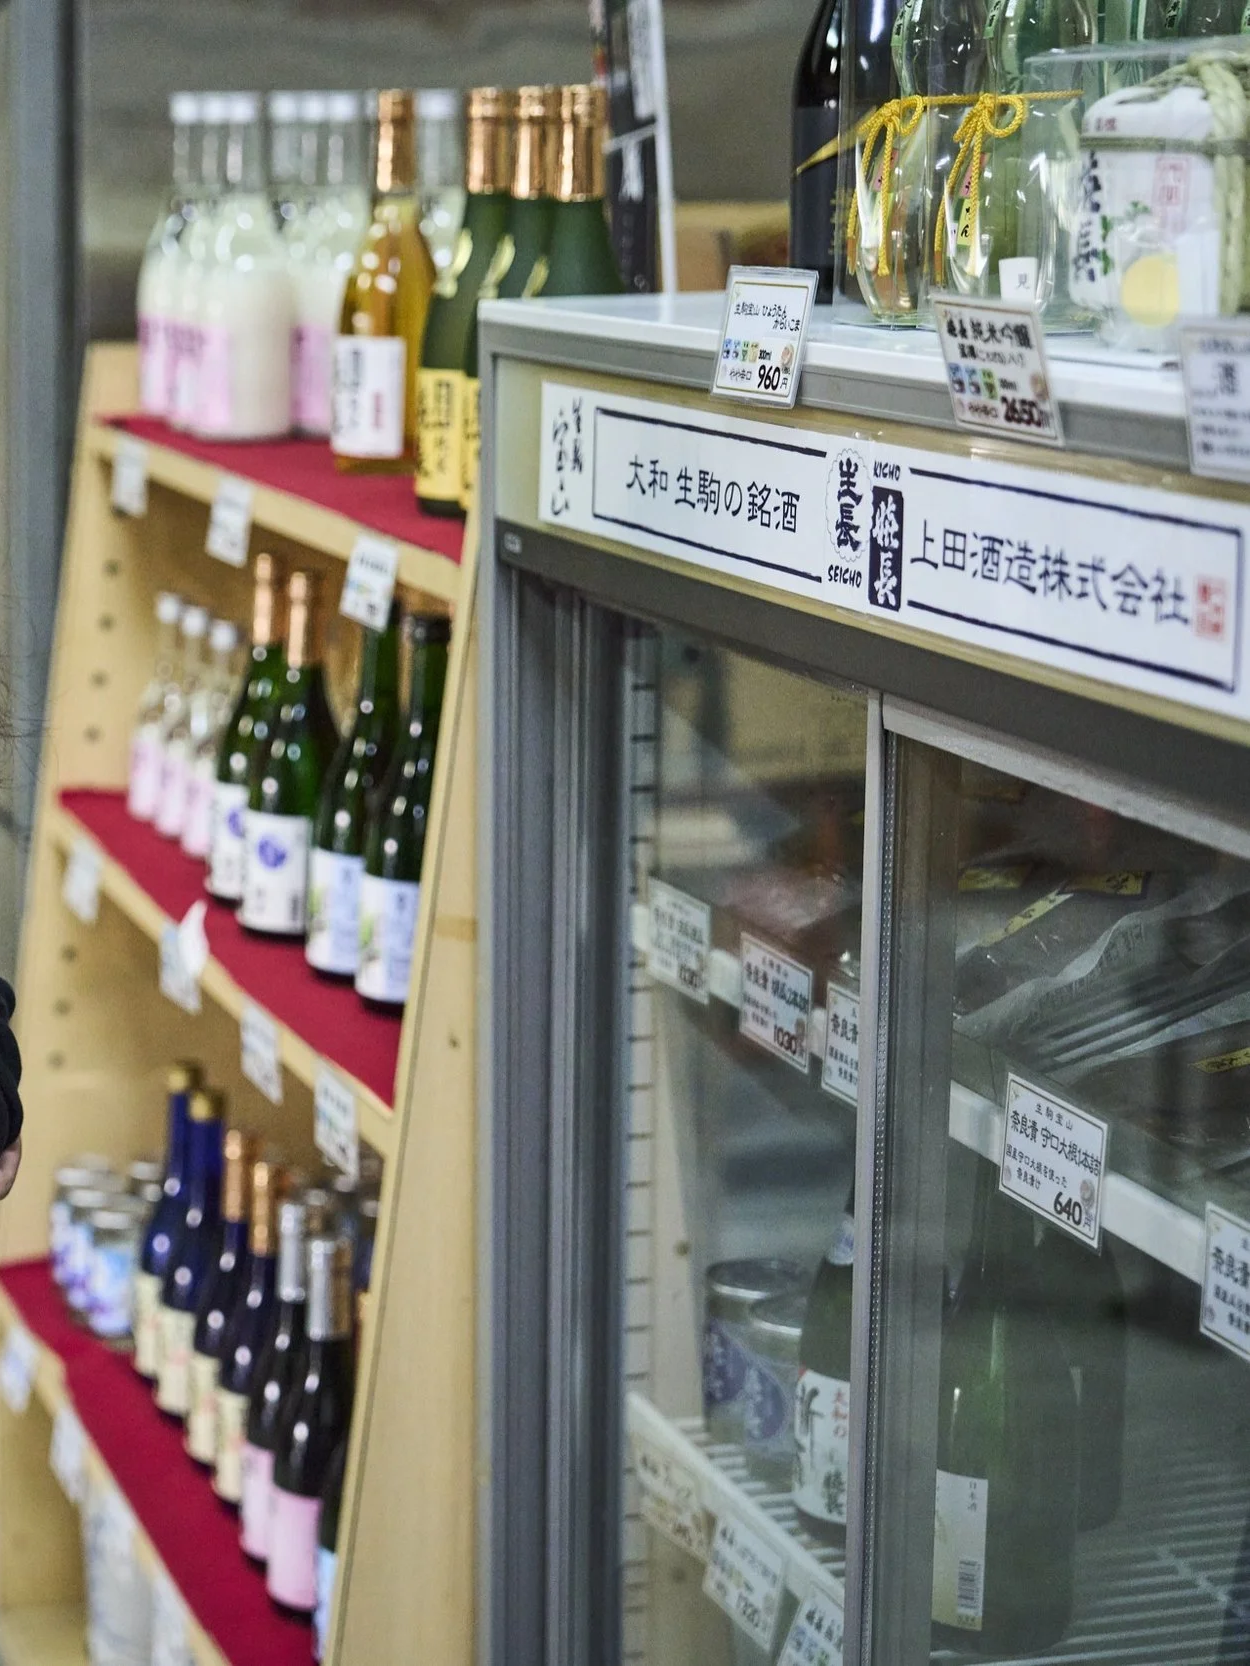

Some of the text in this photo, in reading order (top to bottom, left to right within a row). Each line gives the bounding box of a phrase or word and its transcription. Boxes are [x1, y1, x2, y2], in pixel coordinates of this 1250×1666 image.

[761, 304, 788, 320] ひょうたん
[757, 364, 780, 391] 960
[872, 460, 901, 481] KICHO
[827, 564, 862, 588] SEICHO
[910, 519, 1190, 625] 上田酒造株式会社
[774, 1024, 797, 1056] 1030
[1034, 1102, 1074, 1132] 生駒宝山
[1053, 1191, 1082, 1226] 640
